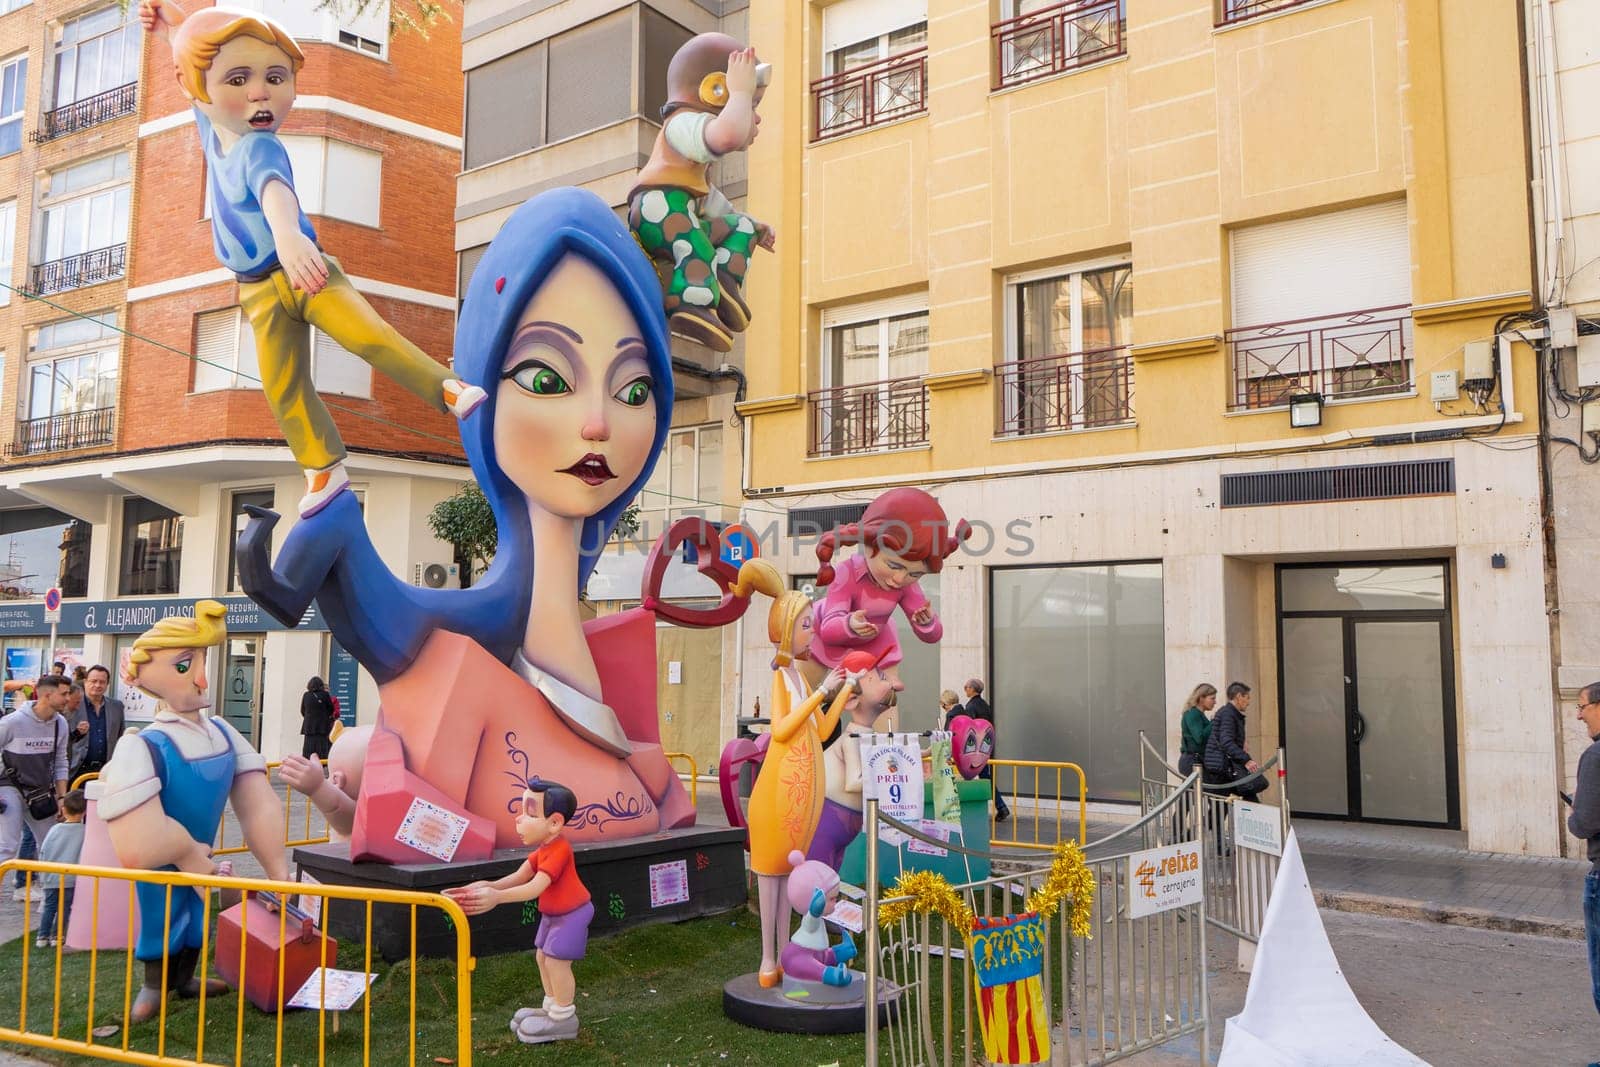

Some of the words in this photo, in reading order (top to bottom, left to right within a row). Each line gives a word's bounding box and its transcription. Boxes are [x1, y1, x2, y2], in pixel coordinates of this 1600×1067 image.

[733, 548, 741, 559] P
[105, 607, 156, 631] ALEJANDRO
[226, 614, 259, 625] SEGUROS
[889, 784, 901, 804] 9
[1161, 849, 1199, 877] reixa
